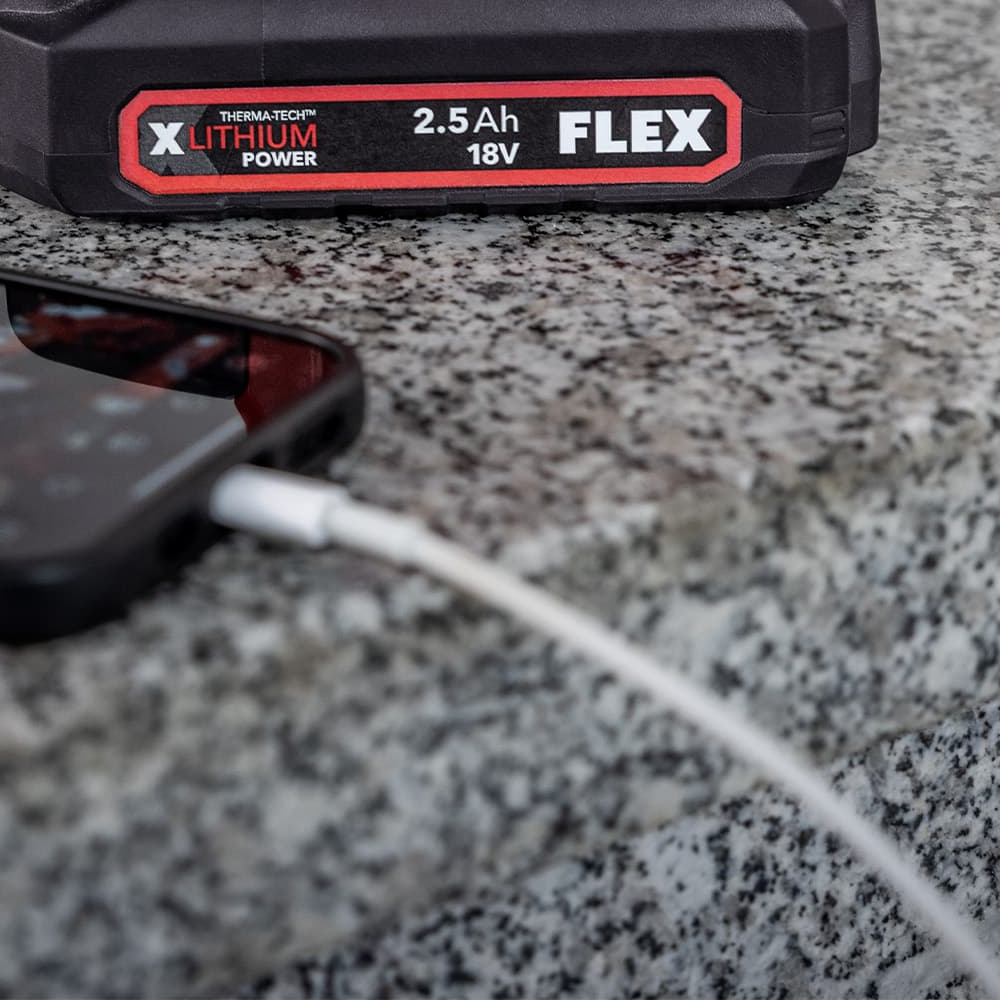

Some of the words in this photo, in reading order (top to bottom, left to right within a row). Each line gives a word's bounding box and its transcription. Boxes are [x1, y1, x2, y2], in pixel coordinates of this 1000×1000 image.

[189, 124, 317, 150] LITHIUM
[559, 108, 712, 154] FLEX
[242, 151, 318, 168] POWER
[467, 142, 520, 165] 18V
